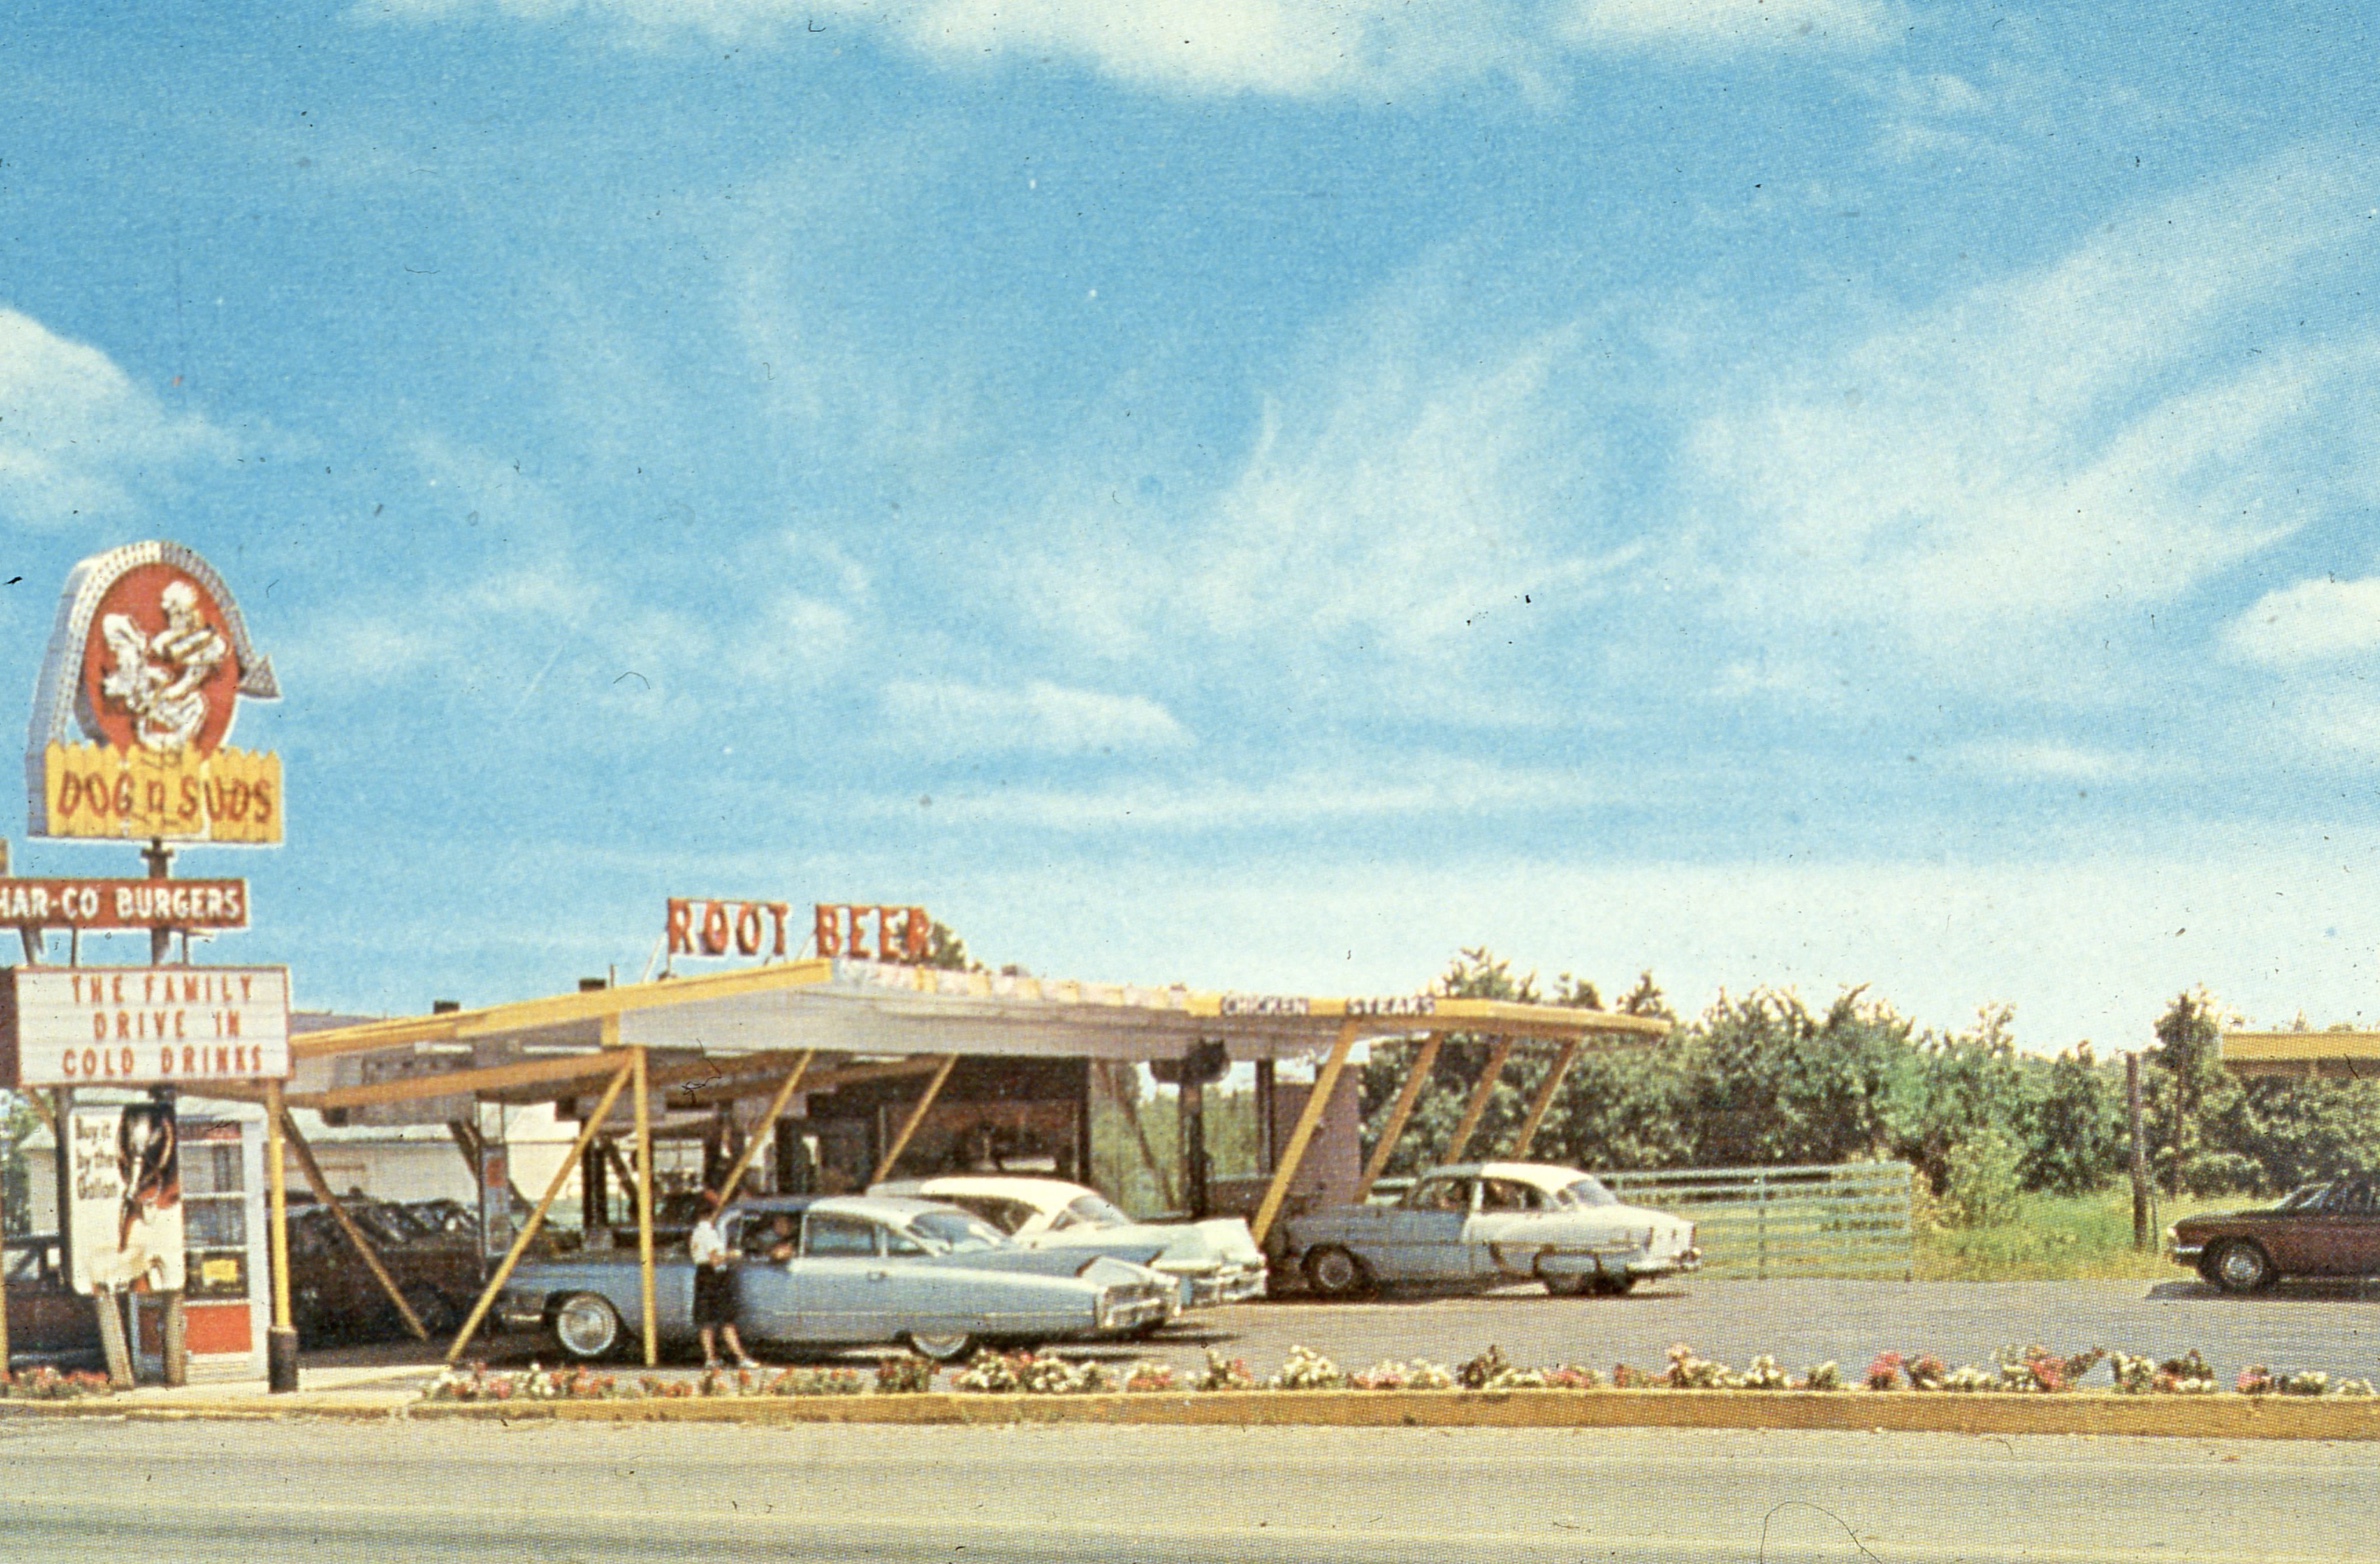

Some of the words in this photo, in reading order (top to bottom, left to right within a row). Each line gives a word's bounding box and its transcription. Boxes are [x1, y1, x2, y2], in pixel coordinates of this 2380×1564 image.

[57, 770, 133, 817] DOG
[177, 775, 272, 823] SUDS
[115, 886, 240, 919] BURGERS
[667, 897, 789, 955] ROOT
[815, 903, 931, 960] BEER
[71, 975, 124, 1004] THE
[145, 975, 252, 1003] FAMILY
[1346, 995, 1435, 1015] STEAKS
[93, 1011, 186, 1040] DRIVE
[215, 1010, 240, 1037] IN
[62, 1048, 134, 1077] COLD
[161, 1045, 262, 1074] DRINKS
